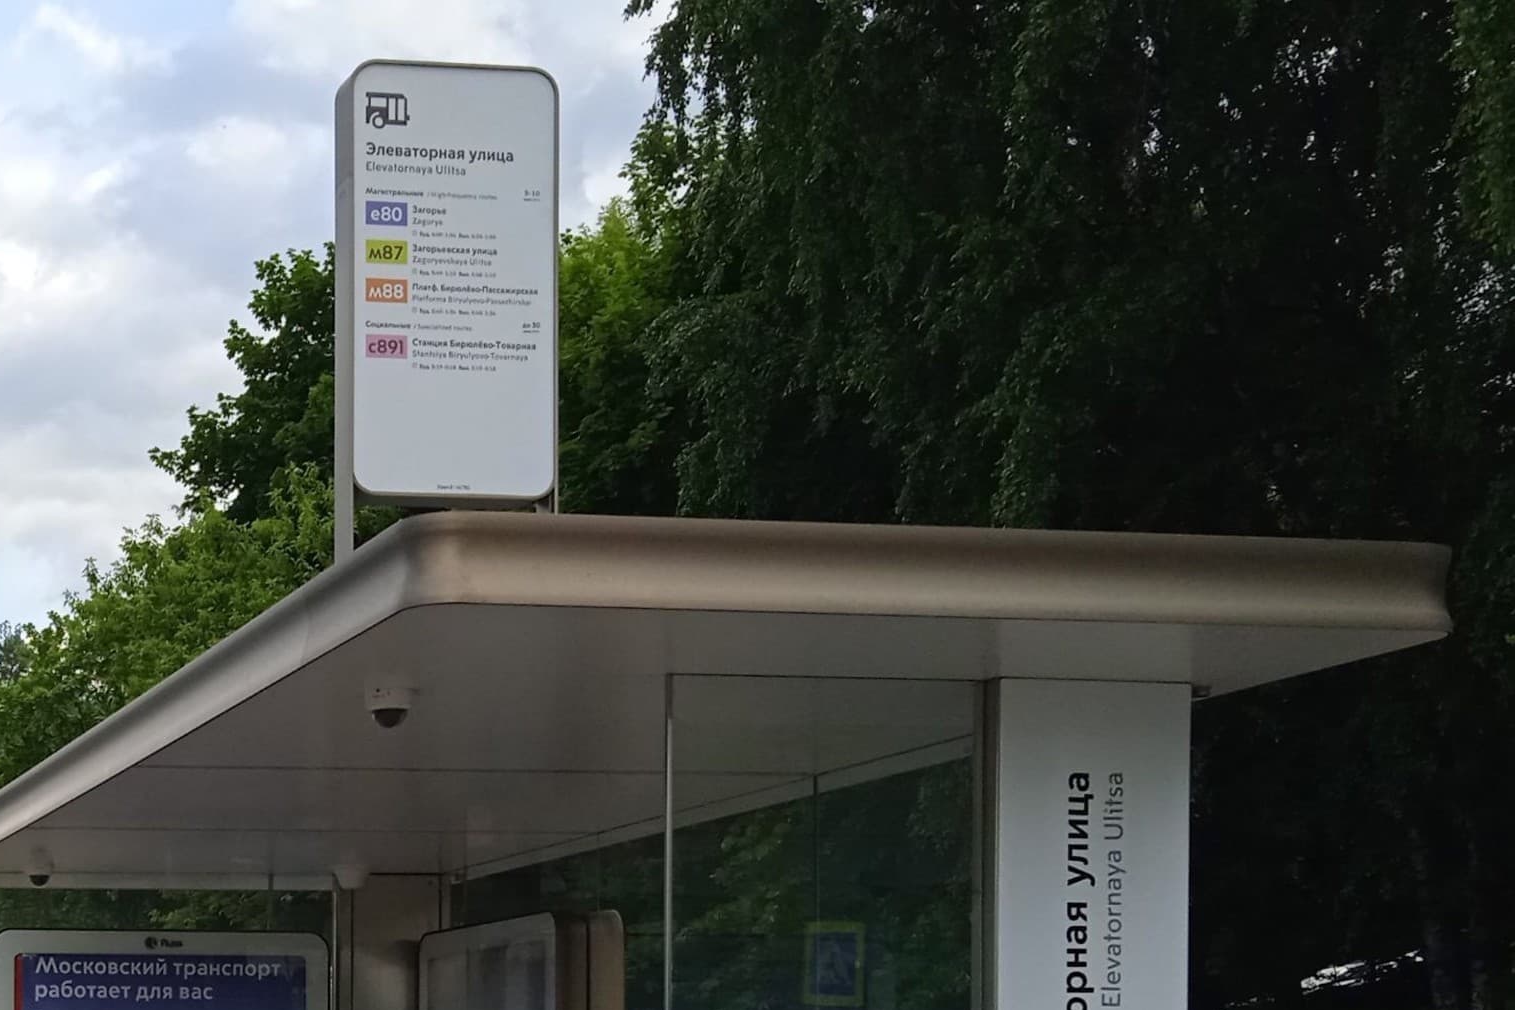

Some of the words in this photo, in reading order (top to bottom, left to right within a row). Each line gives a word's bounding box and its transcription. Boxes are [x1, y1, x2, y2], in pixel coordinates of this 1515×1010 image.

[366, 142, 465, 161] Элеваторная
[469, 150, 514, 164] улица
[366, 161, 433, 176] Elevatornaya
[435, 164, 466, 176] Ulitsa
[1103, 772, 1124, 841] Ulitsa
[1067, 772, 1096, 888] улица
[1101, 850, 1127, 1008] Elevatornaya
[35, 956, 167, 976] Московский
[173, 962, 281, 981] транспорт
[35, 979, 131, 1002] работает
[136, 985, 173, 1002] для
[179, 986, 213, 1000] вас
